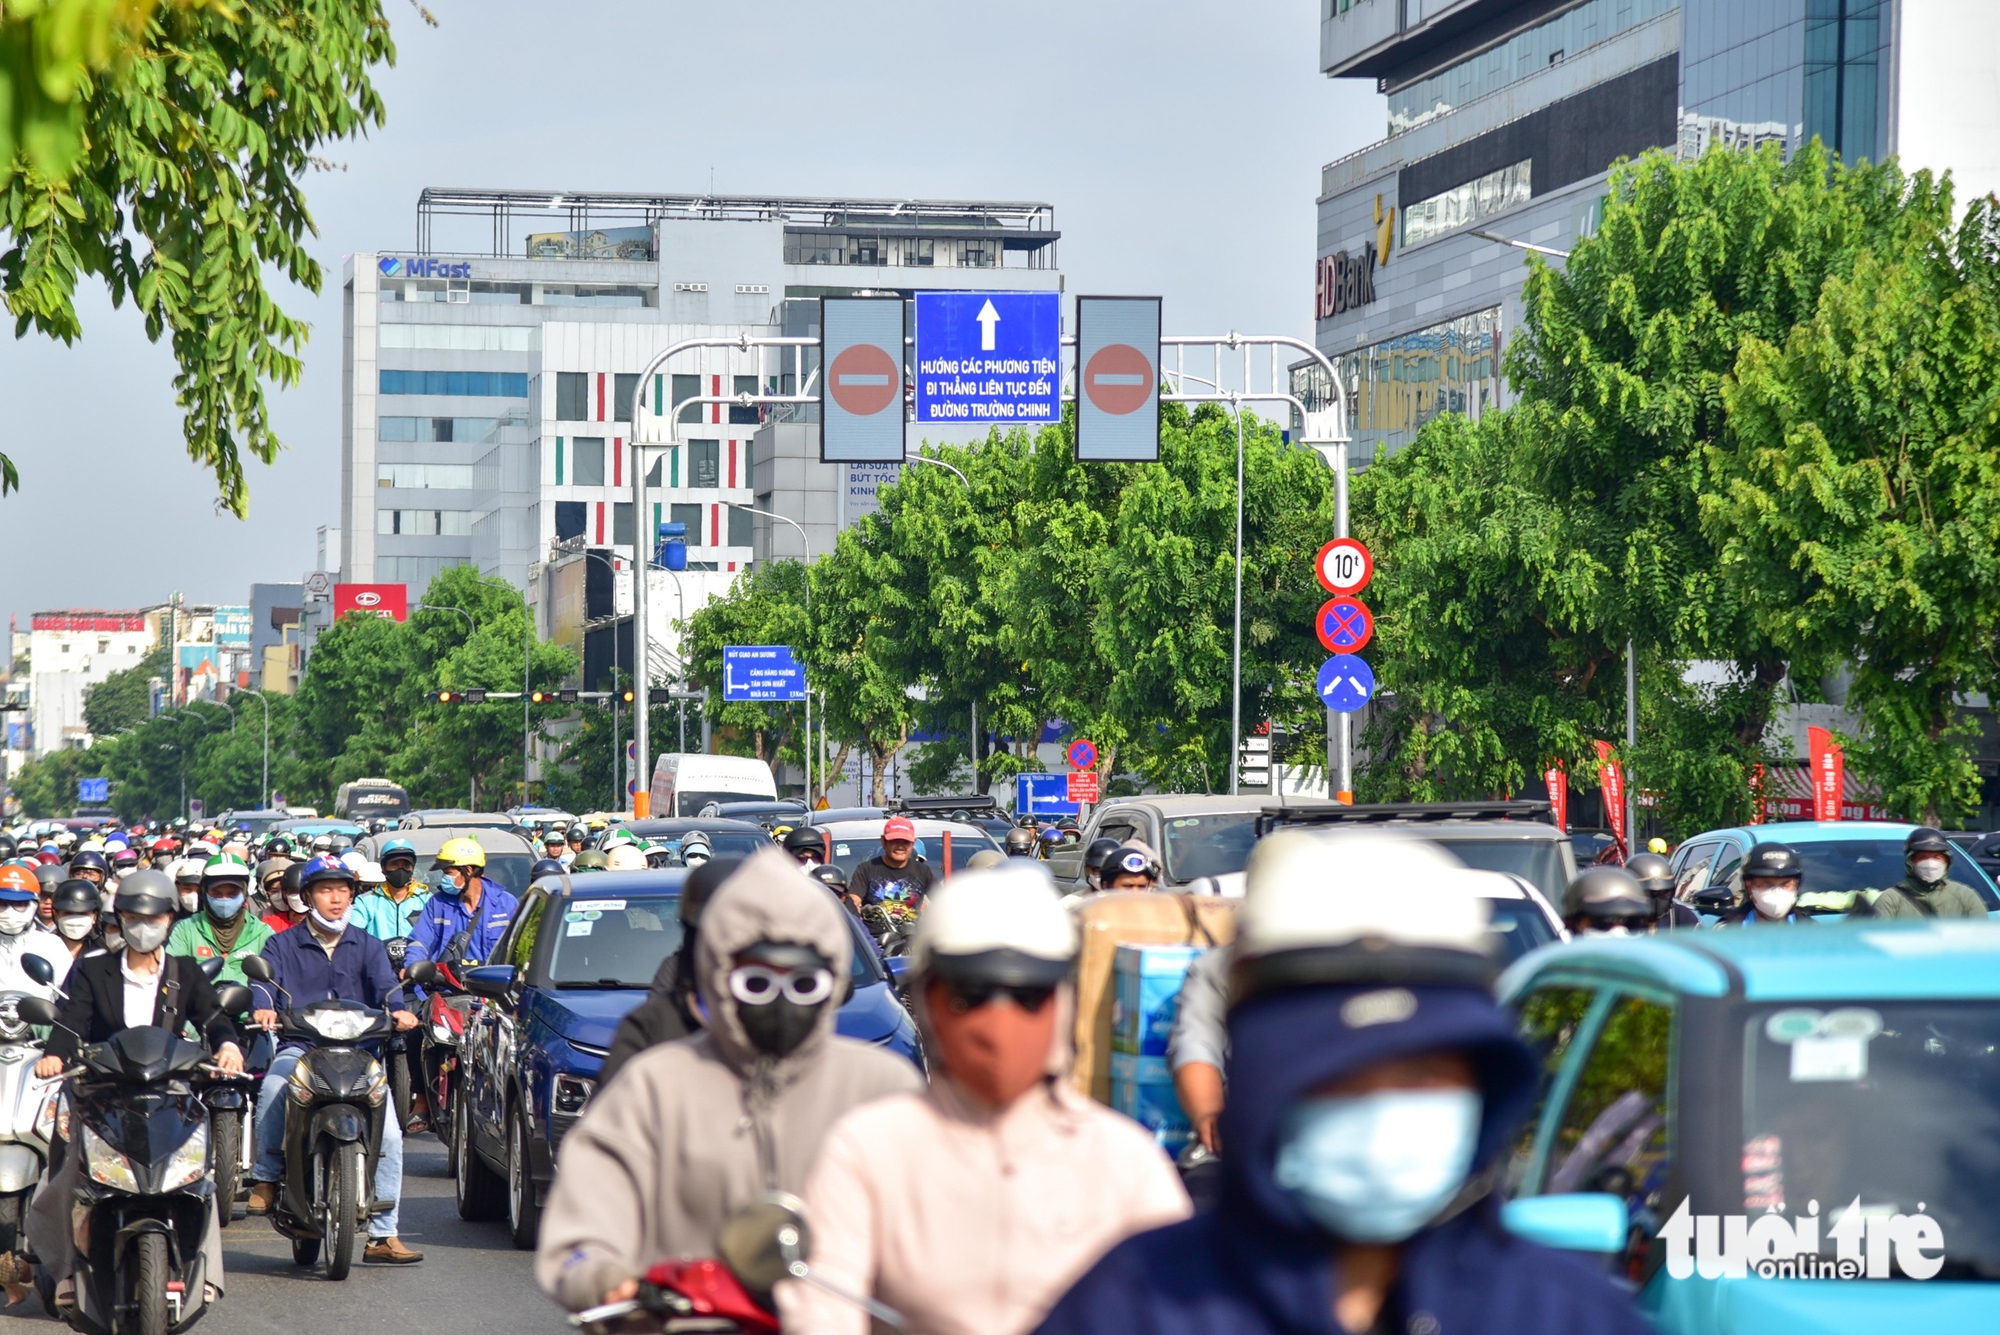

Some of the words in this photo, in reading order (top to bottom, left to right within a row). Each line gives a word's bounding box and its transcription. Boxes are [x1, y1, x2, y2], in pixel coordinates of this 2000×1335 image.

[406, 258, 471, 278] MFast
[1315, 241, 1377, 320] HDBank
[920, 356, 959, 374] HƯỚNG
[960, 356, 983, 374] CÁC
[1031, 357, 1056, 377] TIỆN
[926, 381, 937, 395] ĐI
[939, 375, 977, 396] THẲNG
[979, 379, 1004, 395] LIÊN
[1005, 381, 1027, 399] TỤC
[1028, 376, 1051, 396] ĐẾN
[930, 399, 969, 418] ĐƯỜNG
[971, 399, 1015, 417] TRƯỜNG
[1016, 403, 1050, 417] CHINH
[850, 472, 871, 483] BỨT
[874, 472, 896, 483] TỐC
[850, 487, 875, 496] KINH
[1822, 753, 1834, 770] Hòa
[1823, 771, 1836, 792] Cộng
[1825, 800, 1836, 816] Gòn
